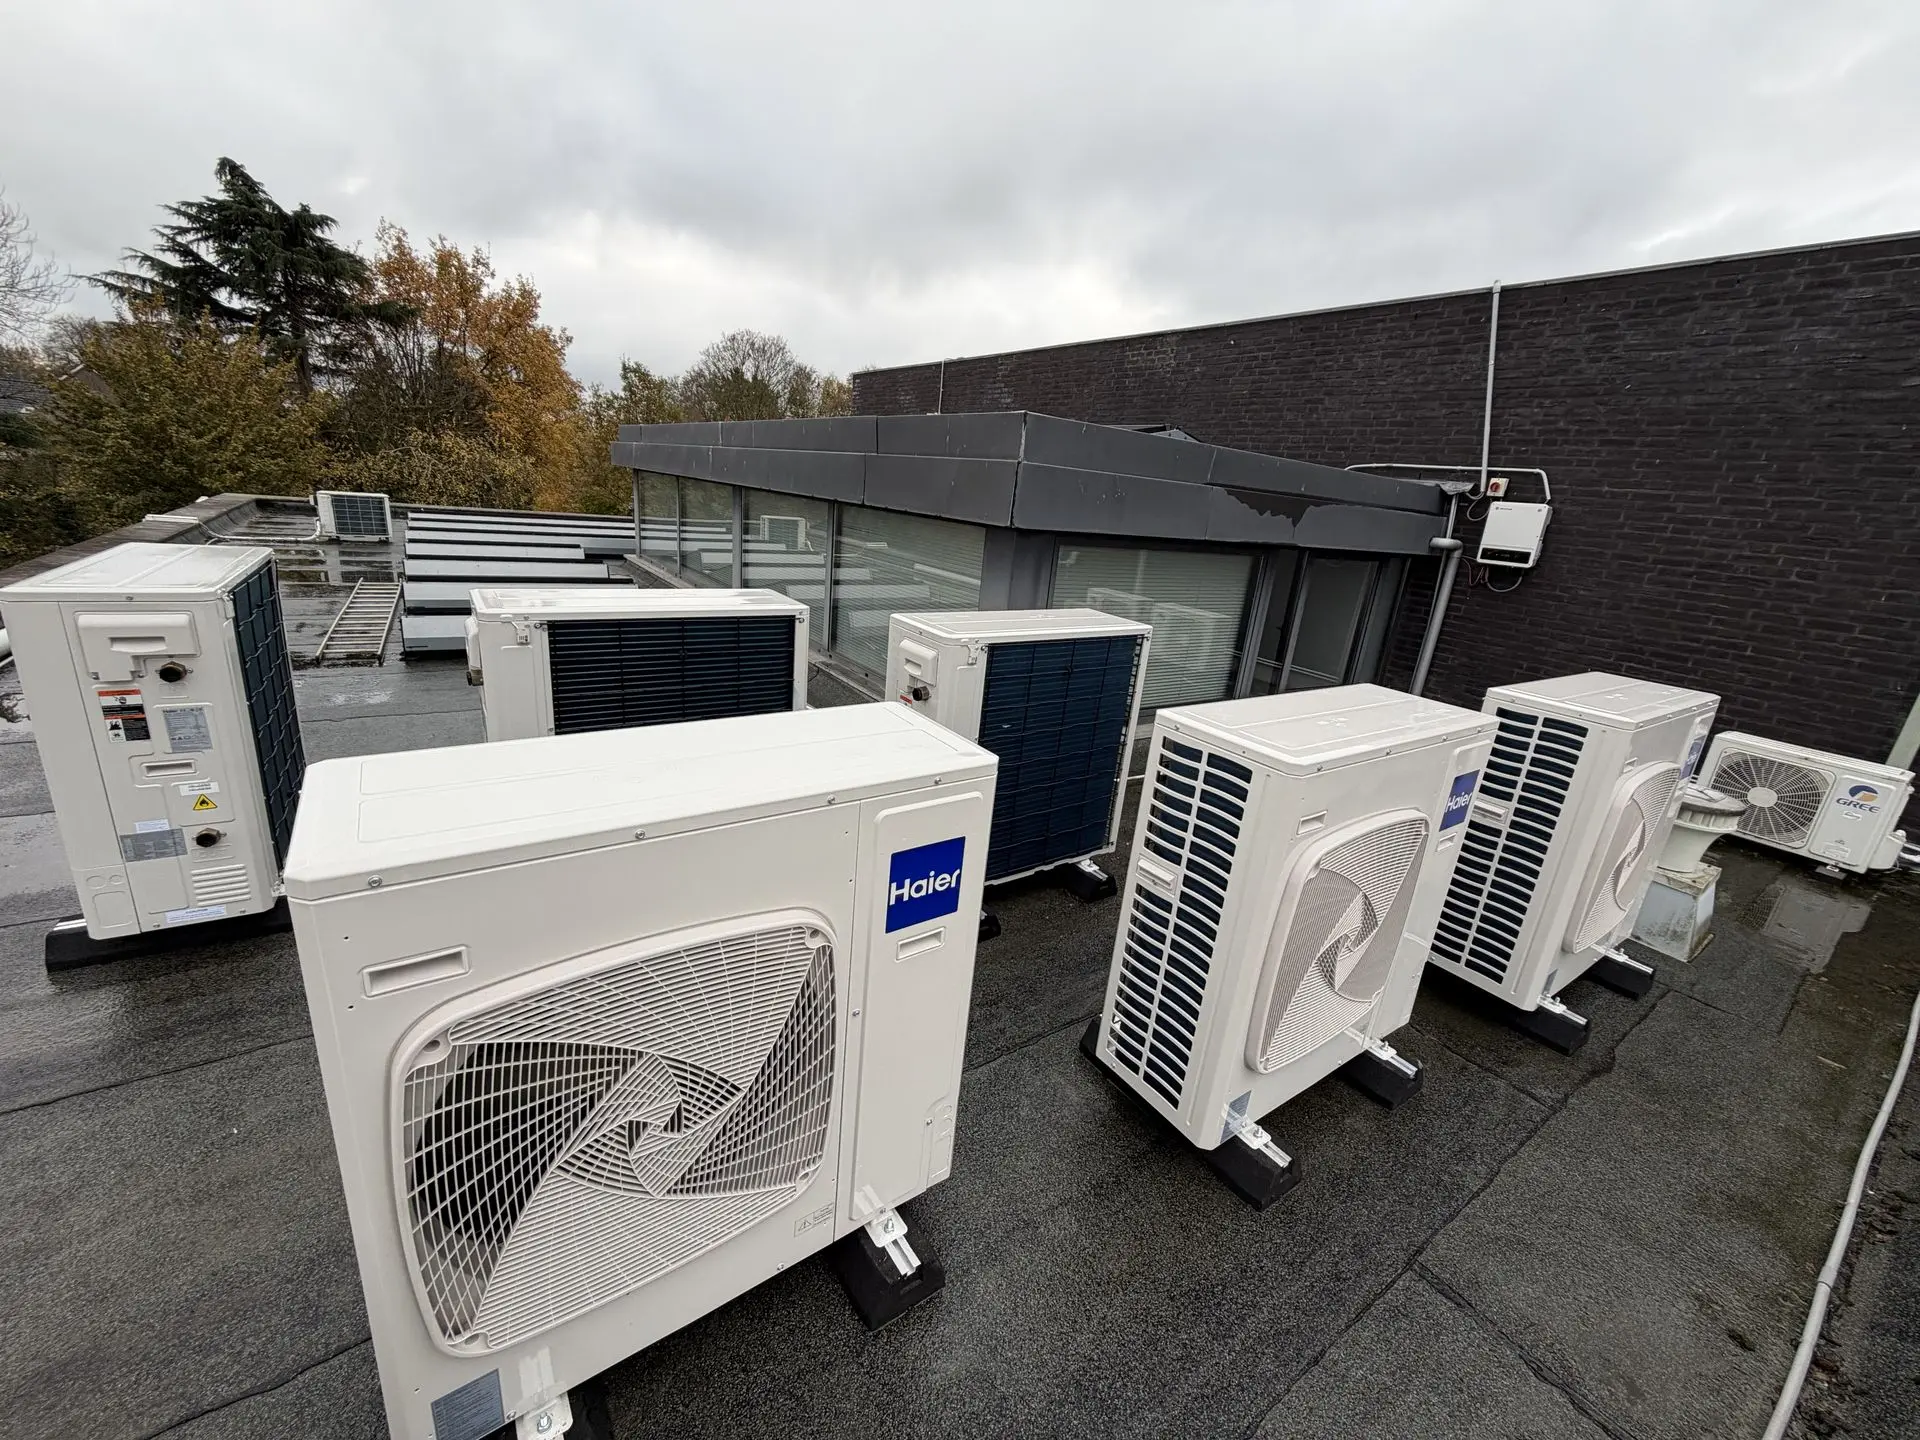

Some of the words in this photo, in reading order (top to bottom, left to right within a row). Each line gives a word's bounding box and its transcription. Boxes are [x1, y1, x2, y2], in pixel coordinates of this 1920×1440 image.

[1445, 791, 1473, 813] Haier
[1836, 797, 1880, 814] GREE
[889, 868, 961, 906] Haier
